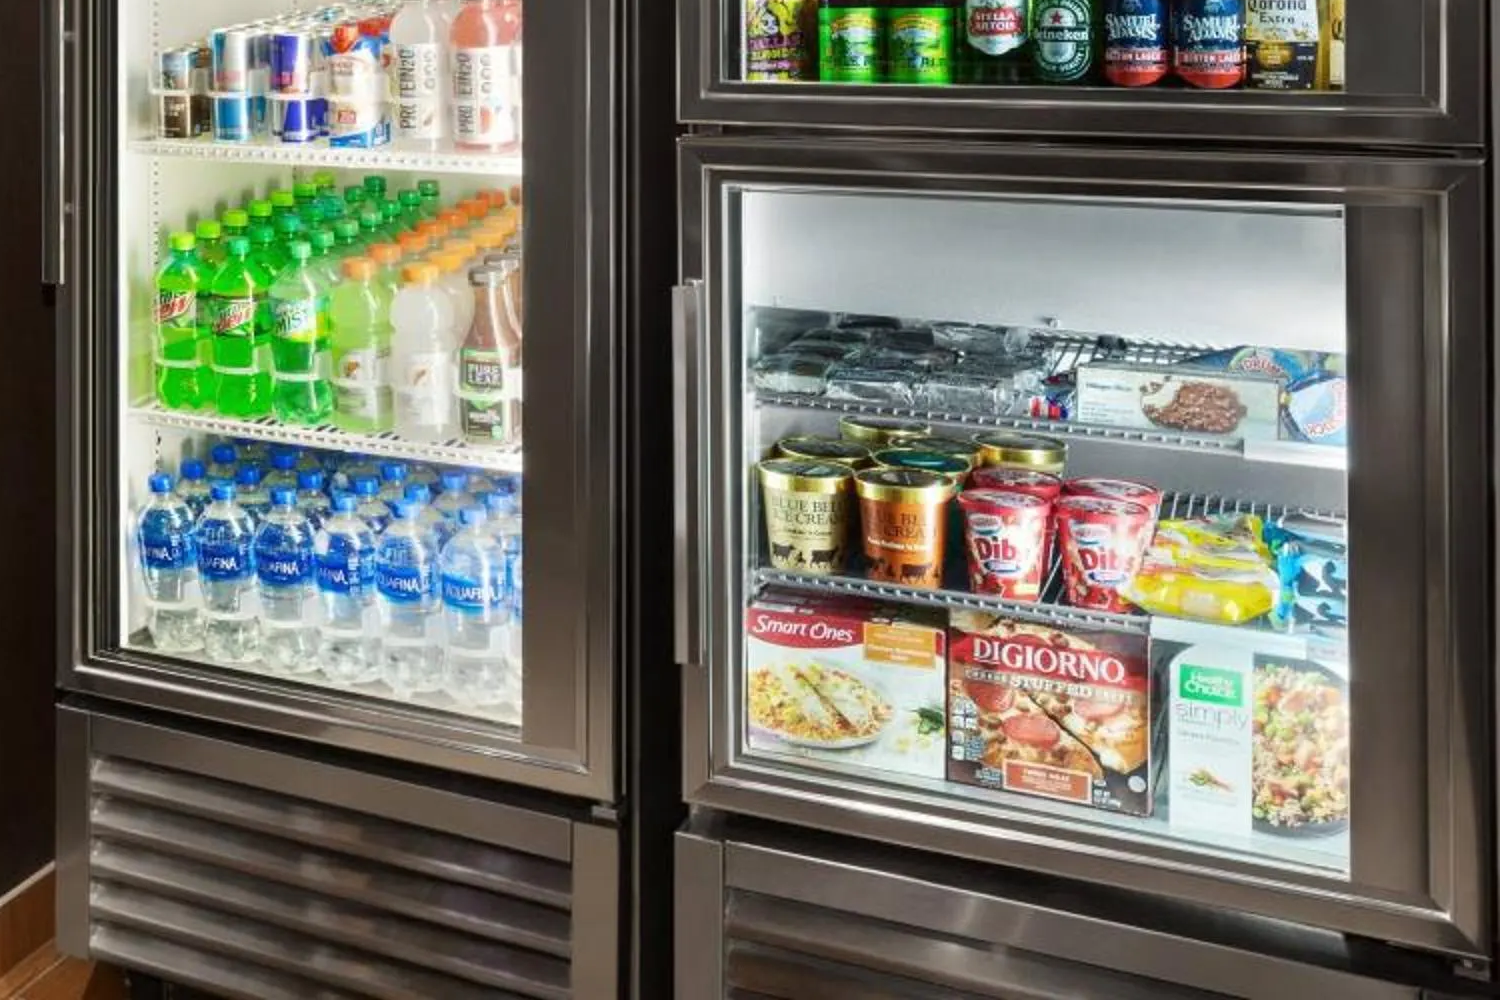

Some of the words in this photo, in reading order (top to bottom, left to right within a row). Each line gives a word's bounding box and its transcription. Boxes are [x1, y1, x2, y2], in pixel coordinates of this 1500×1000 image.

[973, 10, 1016, 23] STELLA
[1105, 13, 1158, 30] SAMUEL
[1183, 13, 1240, 31] SAMUEL
[1259, 11, 1296, 25] Extra
[752, 614, 807, 635] Smart
[809, 621, 855, 643] Ones
[972, 637, 1126, 685] DIGIORNO
[1175, 700, 1249, 731] simply
